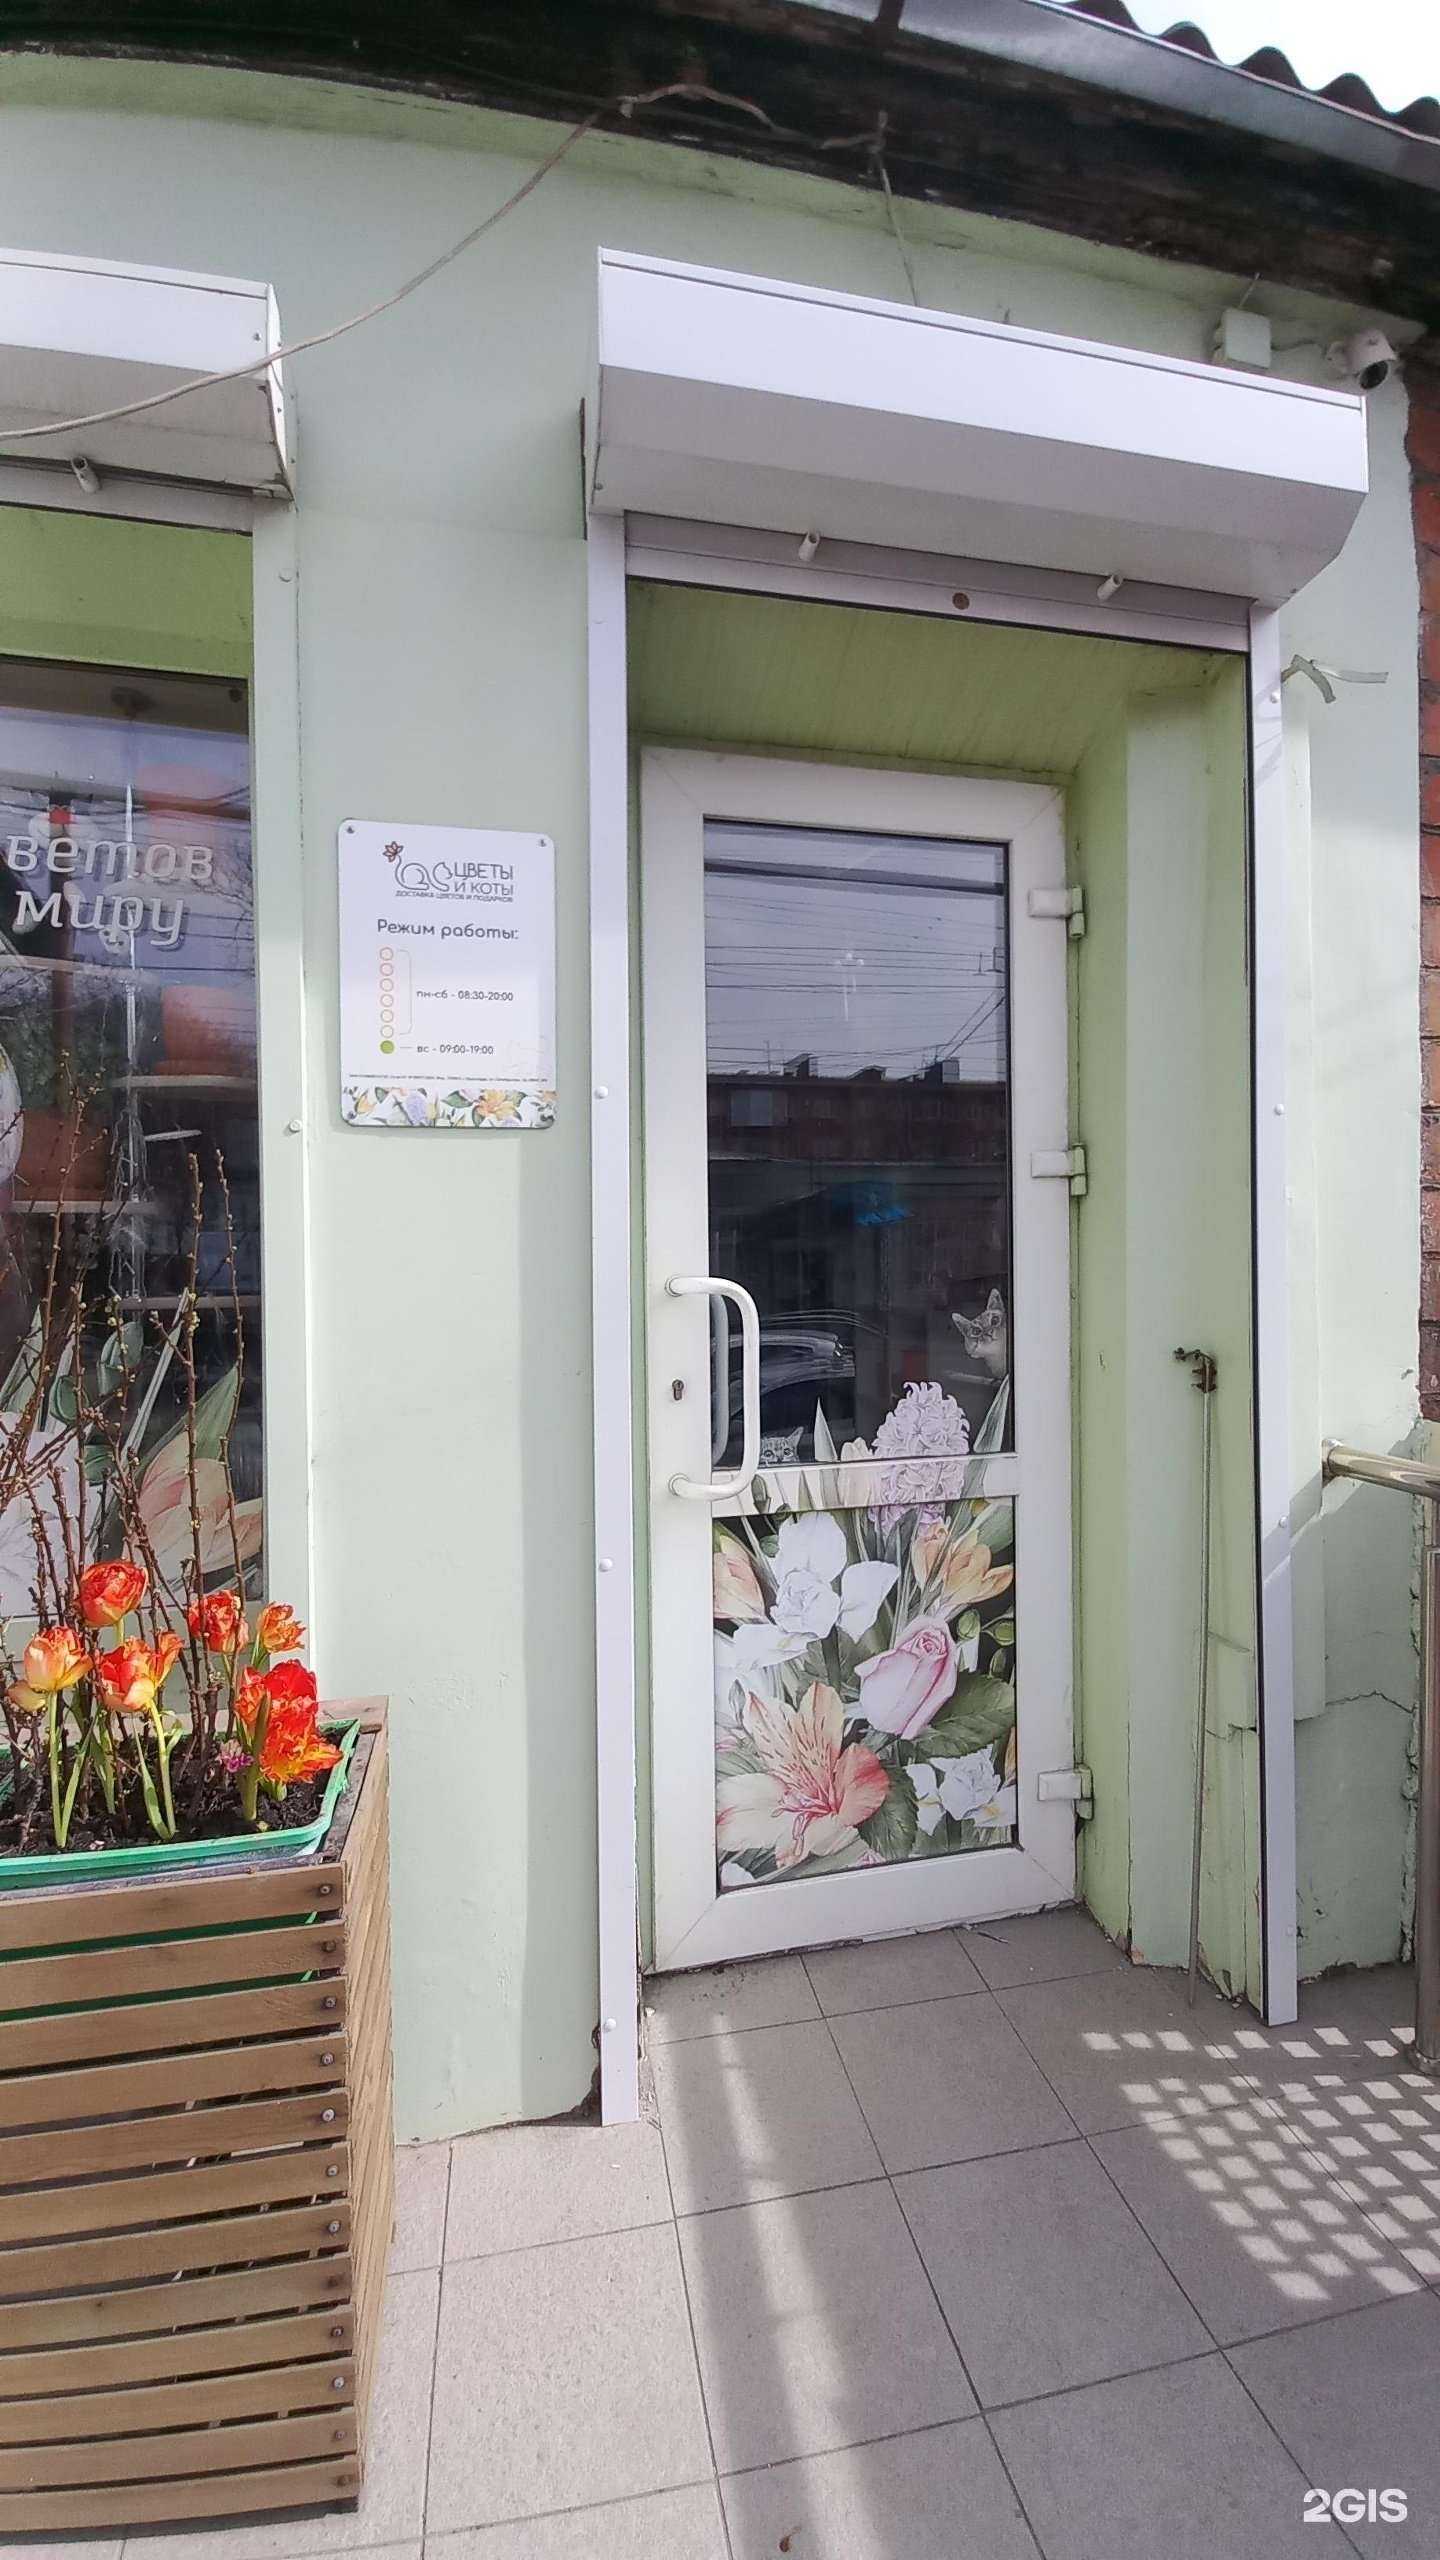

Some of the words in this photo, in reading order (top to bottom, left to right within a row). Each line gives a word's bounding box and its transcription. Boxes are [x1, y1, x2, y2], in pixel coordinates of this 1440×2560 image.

[454, 862, 514, 880] ЦВЕТЫ
[454, 882, 466, 892] И
[471, 882, 514, 896] КОТЫ
[15, 890, 184, 946] миру
[377, 918, 435, 936] Режим
[440, 922, 519, 940] работы:
[416, 989, 448, 999] пн-сб
[457, 990, 514, 1001] 08:30-20:00
[417, 1045, 430, 1053] вс
[439, 1044, 494, 1055] 09:00-19:00
